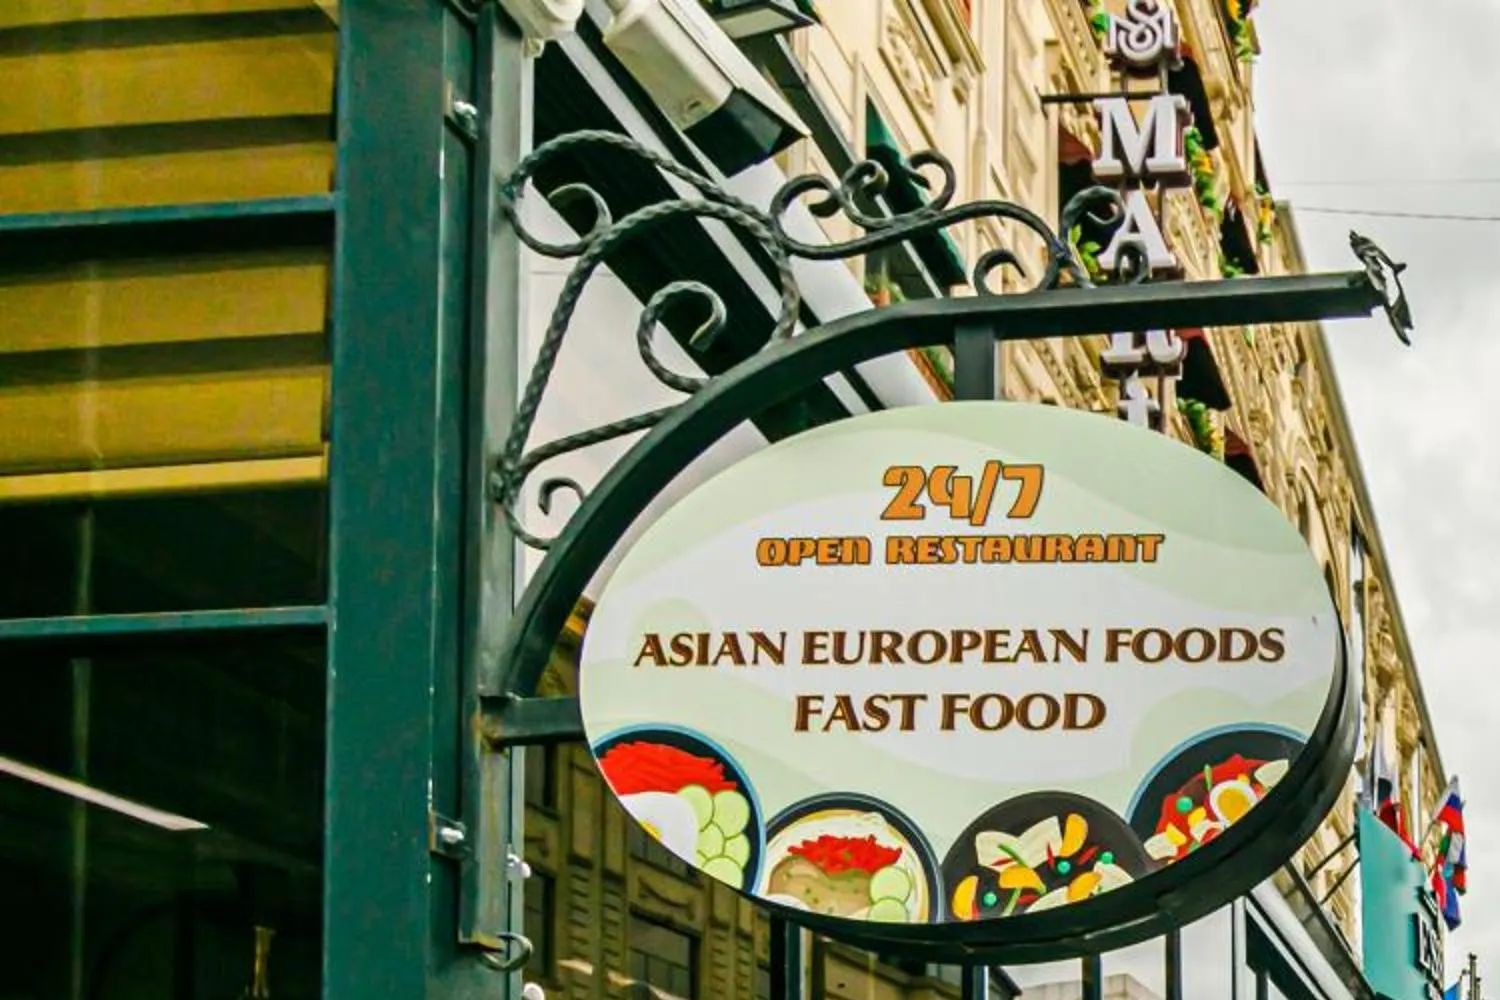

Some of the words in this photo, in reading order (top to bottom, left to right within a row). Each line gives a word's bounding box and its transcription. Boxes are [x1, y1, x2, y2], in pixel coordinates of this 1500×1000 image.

[880, 460, 1044, 526] 24/7
[756, 537, 871, 566] OPEN
[886, 534, 1165, 564] RESTAURANT
[634, 632, 786, 666] ASIAN
[802, 629, 1088, 664] EUROPEAN
[1105, 628, 1284, 663] FOODS
[795, 694, 927, 732] FAST
[941, 694, 1106, 730] FOOD
